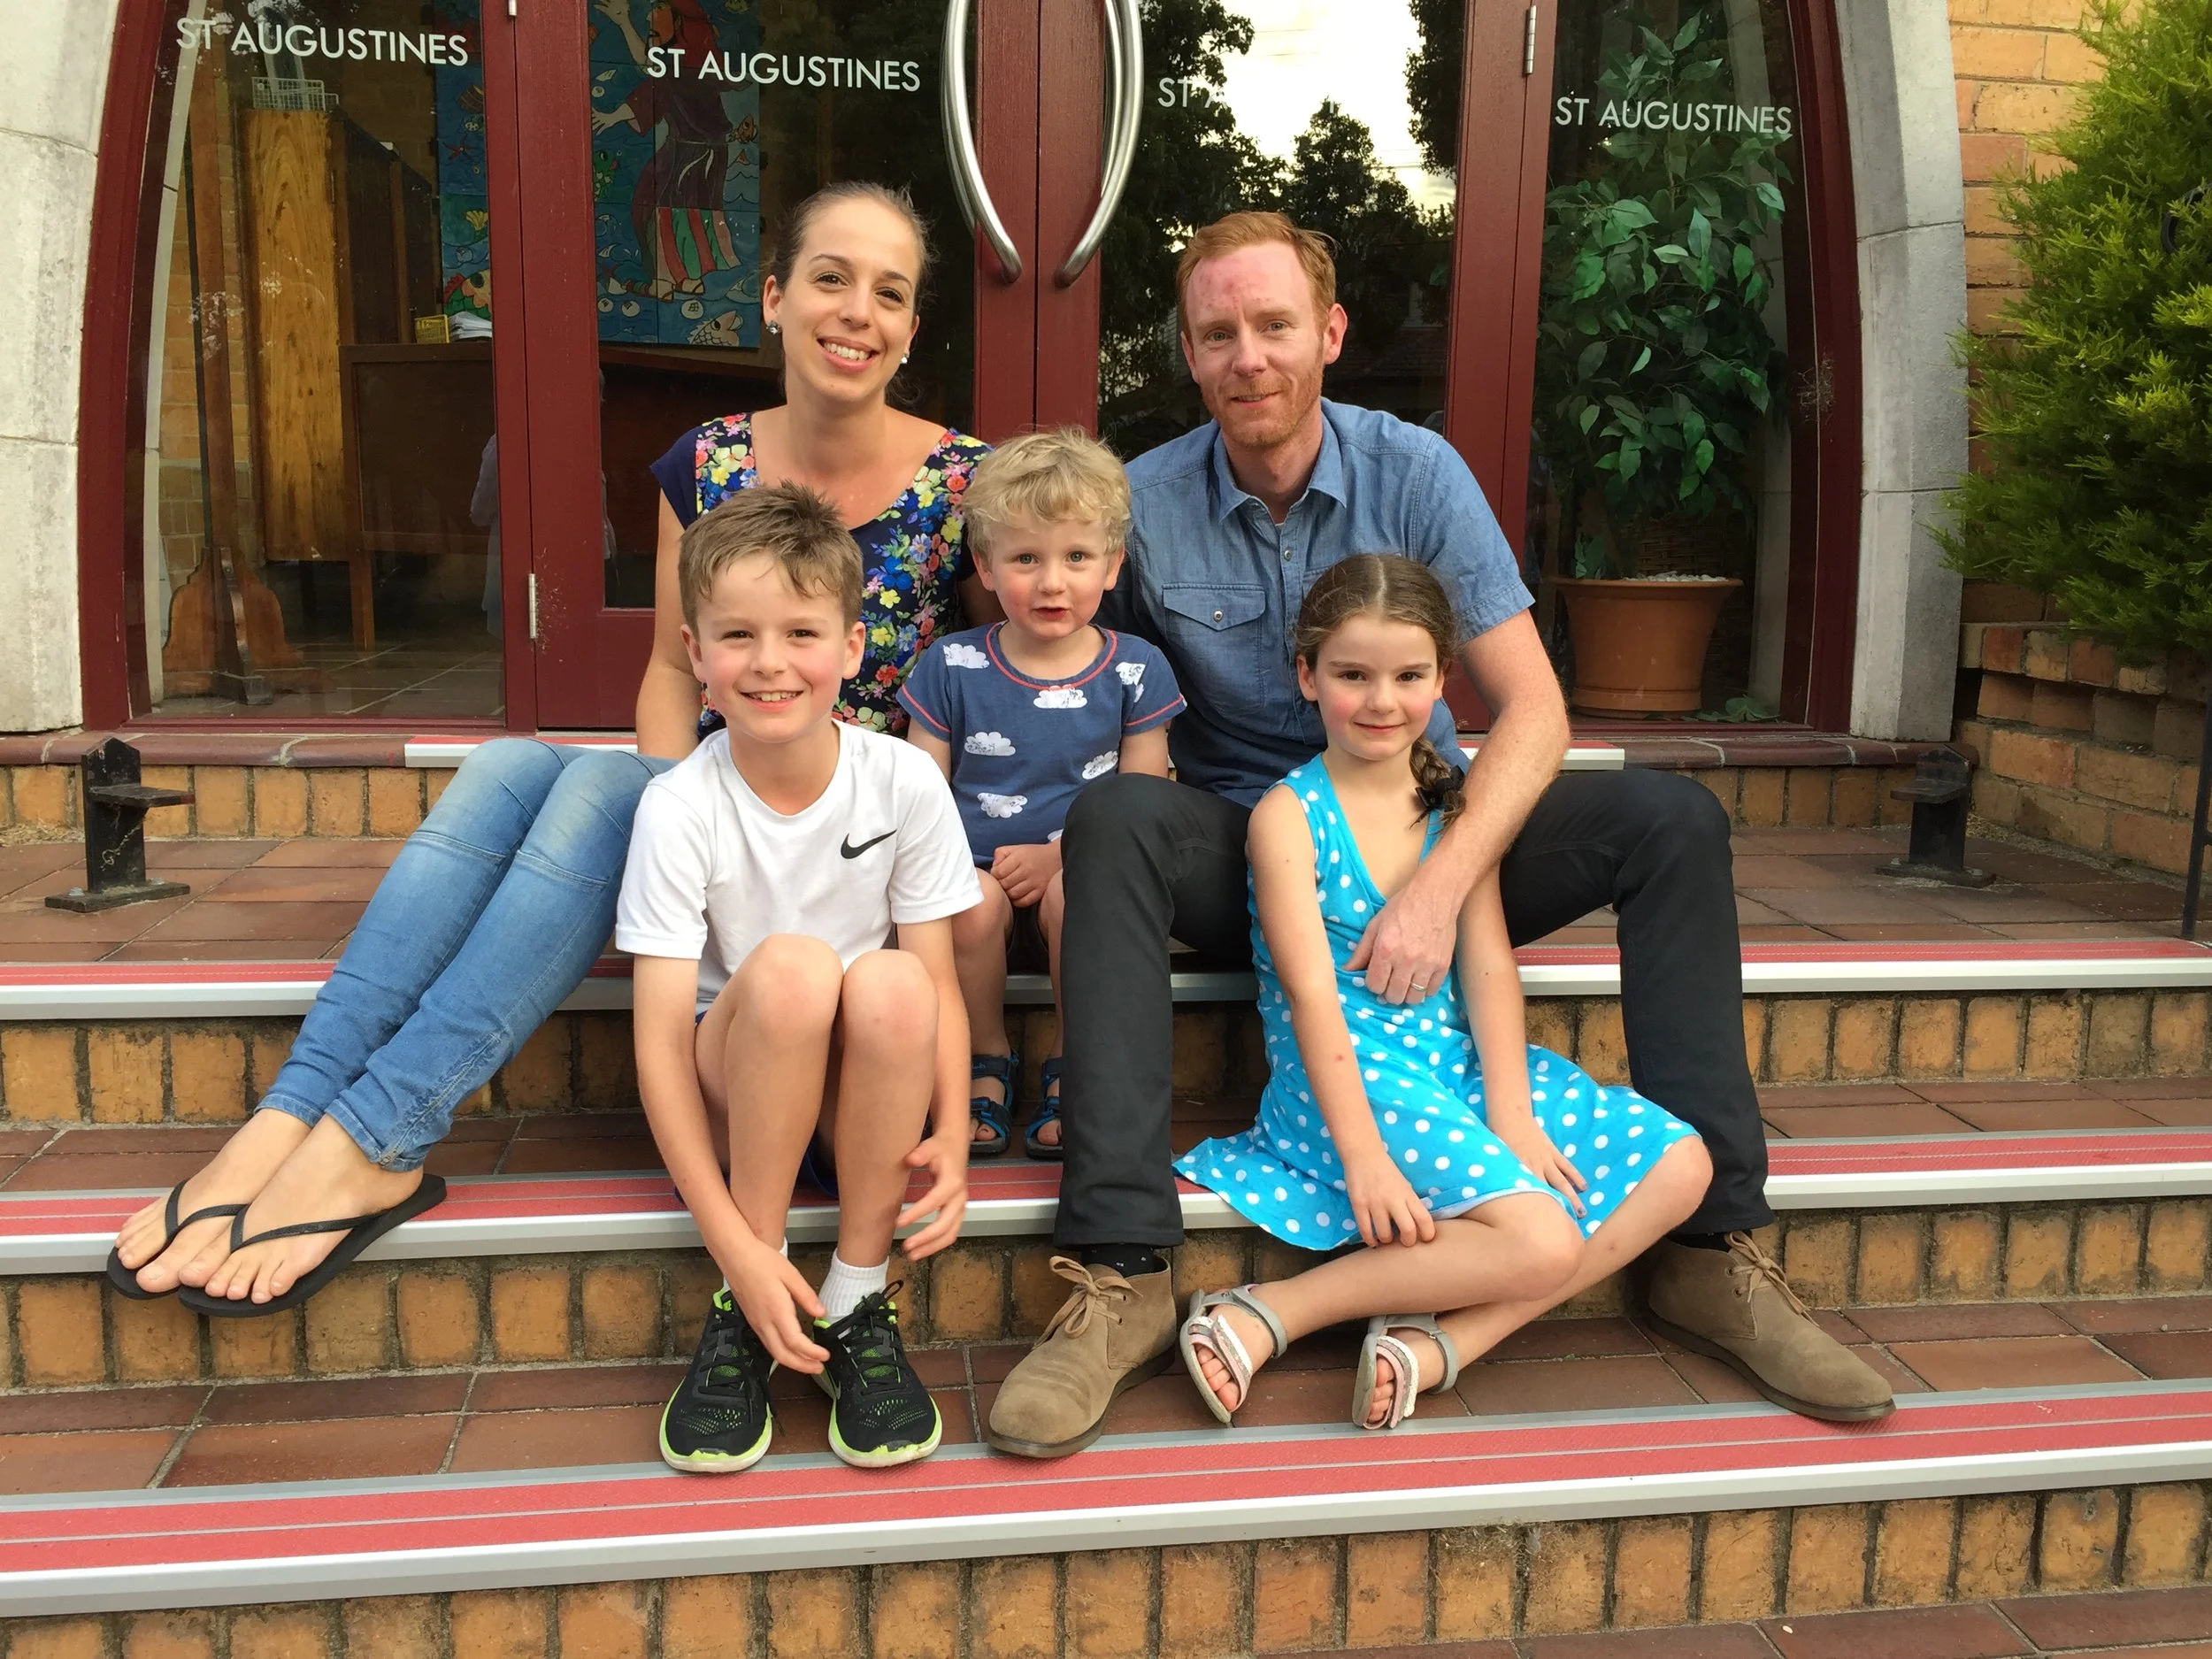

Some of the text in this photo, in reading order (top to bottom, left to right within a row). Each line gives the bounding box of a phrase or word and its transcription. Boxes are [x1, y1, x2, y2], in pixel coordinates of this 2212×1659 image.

[176, 18, 468, 66] ST AUGUSTINES
[647, 46, 920, 92] ST AUGUSTINES
[1157, 77, 1193, 107] ST
[1555, 96, 1792, 134] ST AUGUSTINES
